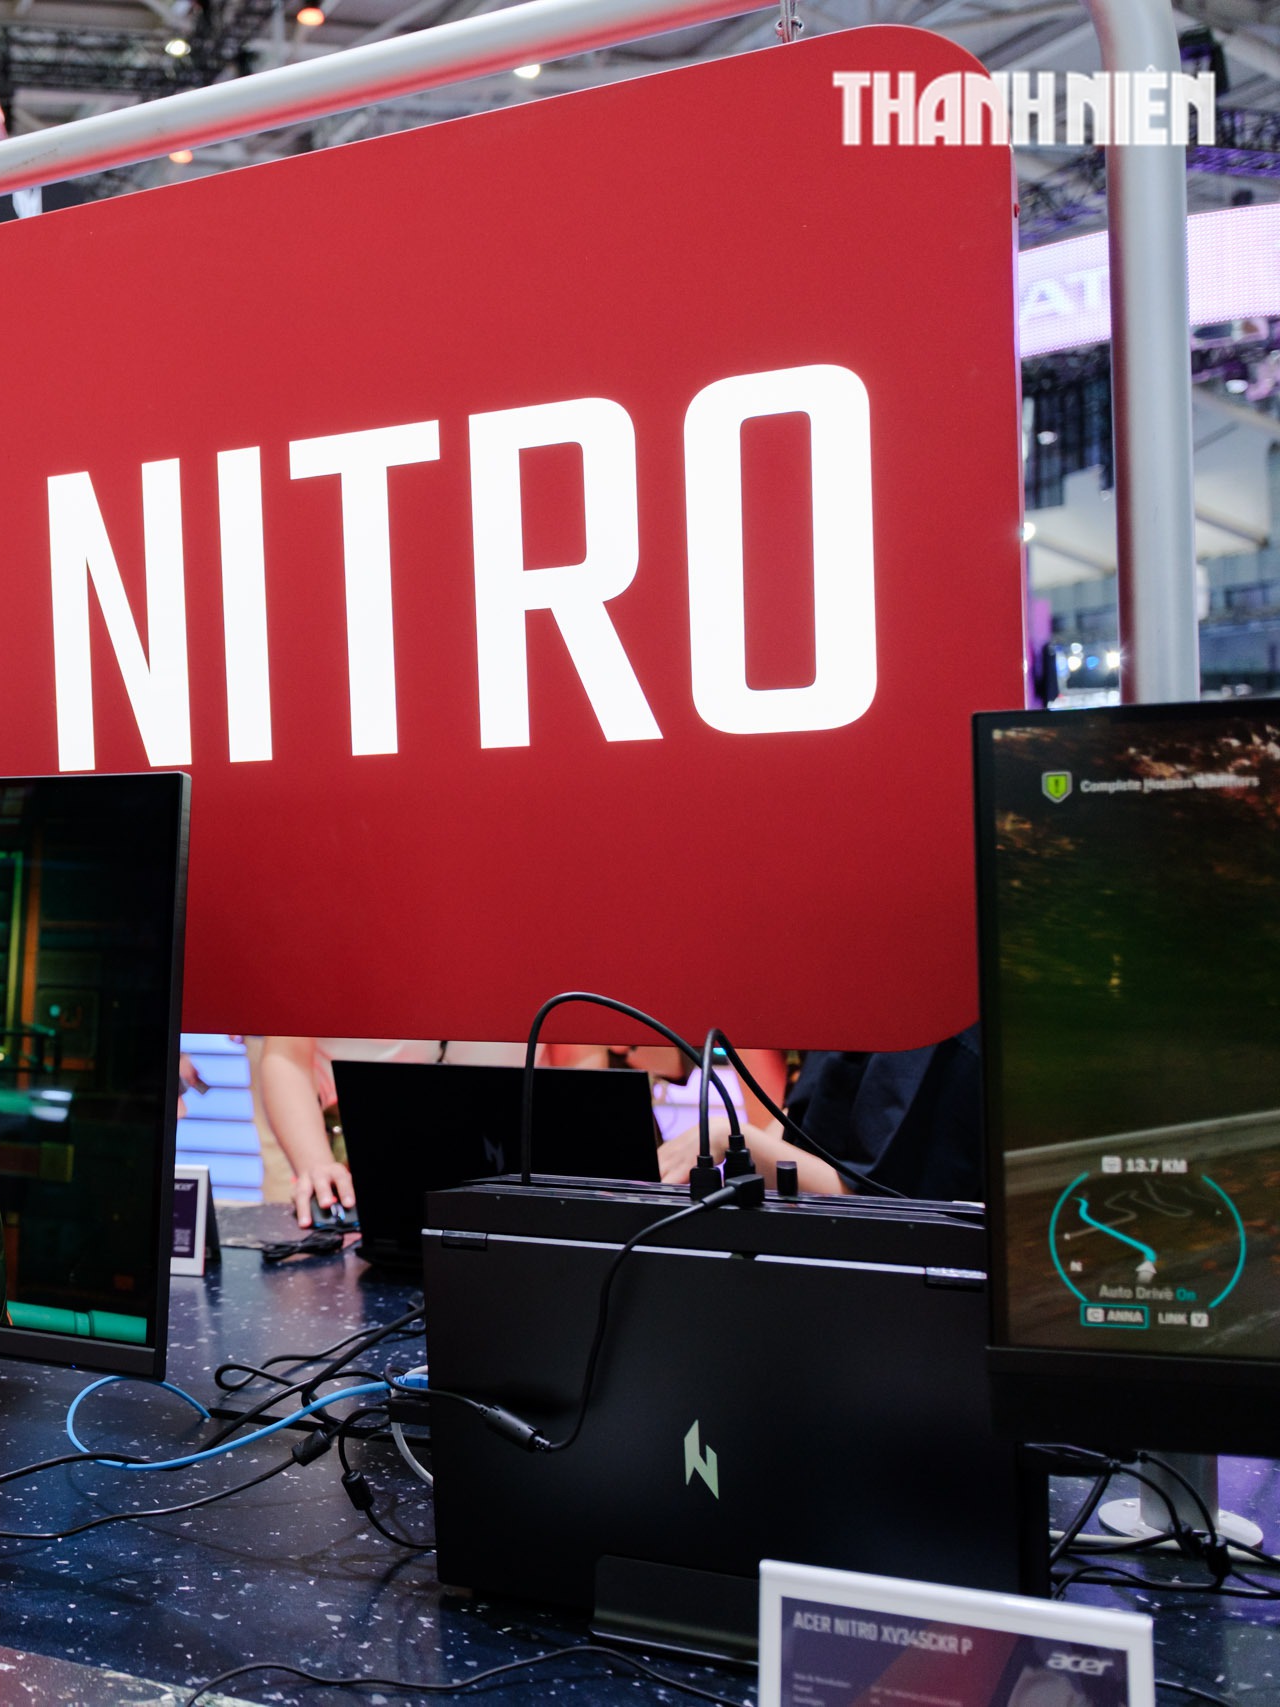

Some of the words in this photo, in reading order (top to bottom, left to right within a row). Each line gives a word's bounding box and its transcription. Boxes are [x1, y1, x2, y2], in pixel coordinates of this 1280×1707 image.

[47, 364, 878, 772] NITRO
[1125, 1158, 1160, 1173] 13.7
[1162, 1158, 1187, 1173] KM
[1099, 1285, 1133, 1299] Auto
[1135, 1287, 1174, 1300] Drive
[1175, 1287, 1197, 1300] On
[1107, 1310, 1143, 1324] ANNA
[1157, 1312, 1188, 1326] LINK
[792, 1611, 832, 1634] ACER
[833, 1617, 879, 1642] NITRO
[960, 1637, 973, 1656] P
[1047, 1652, 1114, 1676] acer
